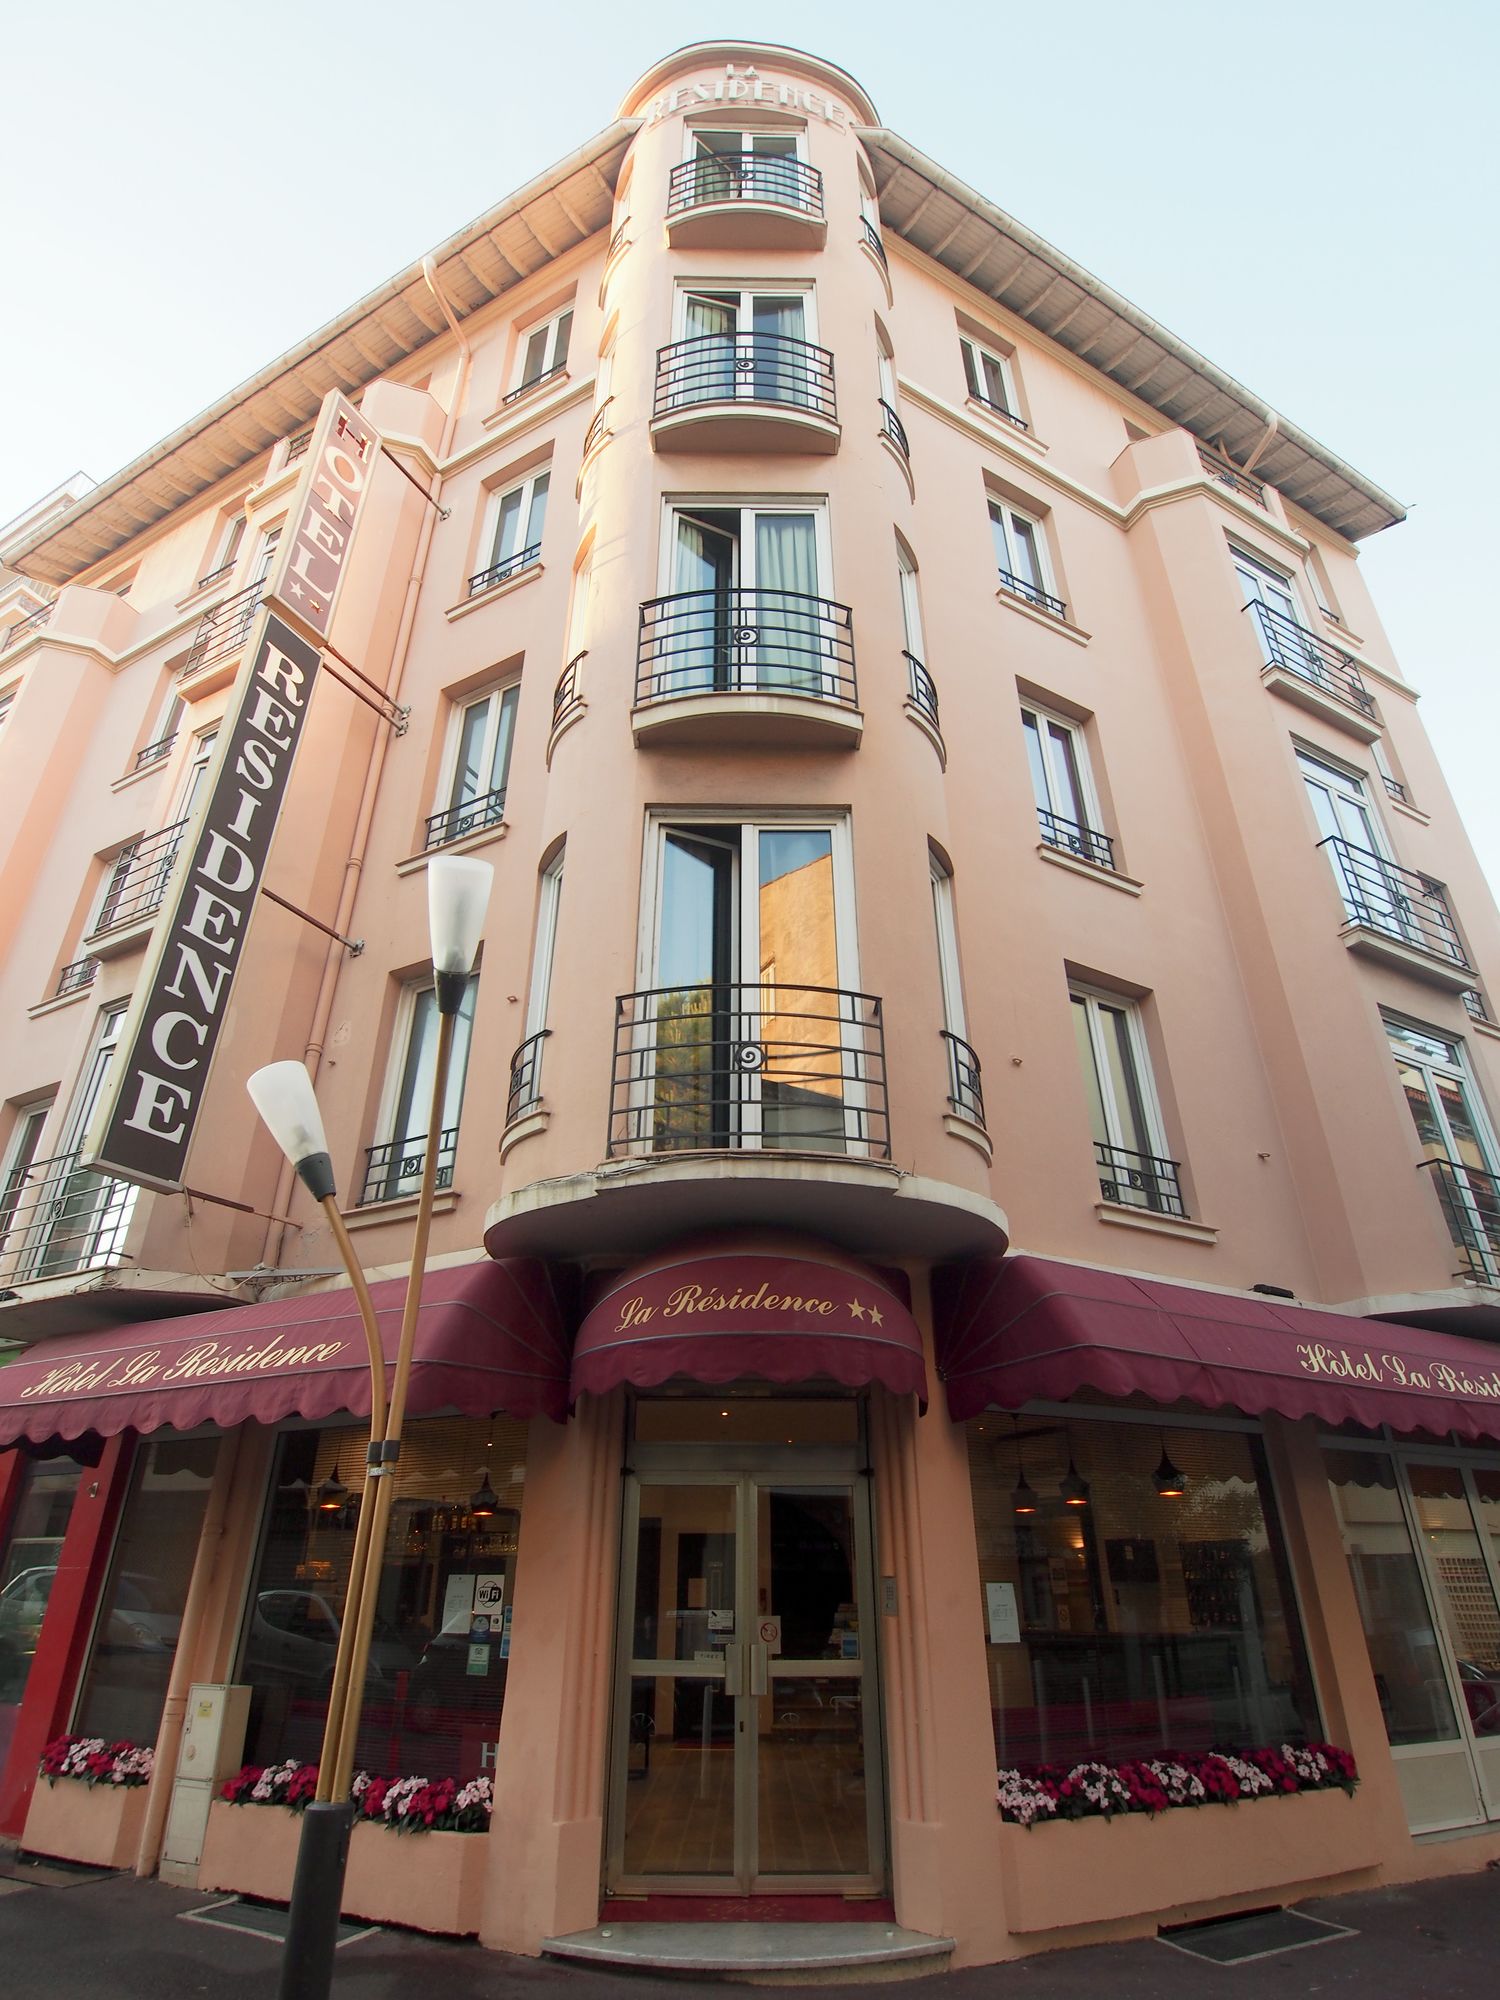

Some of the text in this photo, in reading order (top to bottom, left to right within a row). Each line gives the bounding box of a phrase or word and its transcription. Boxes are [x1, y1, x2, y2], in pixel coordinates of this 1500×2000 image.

[726, 63, 760, 79] LA
[289, 409, 373, 602] HOTEL
[123, 640, 305, 1144] RESIDENCE
[614, 1282, 839, 1332] La Résidence
[20, 1334, 351, 1398] Hôtel La Résidence
[1296, 1343, 1383, 1382] Hôtel
[1382, 1354, 1431, 1389] La
